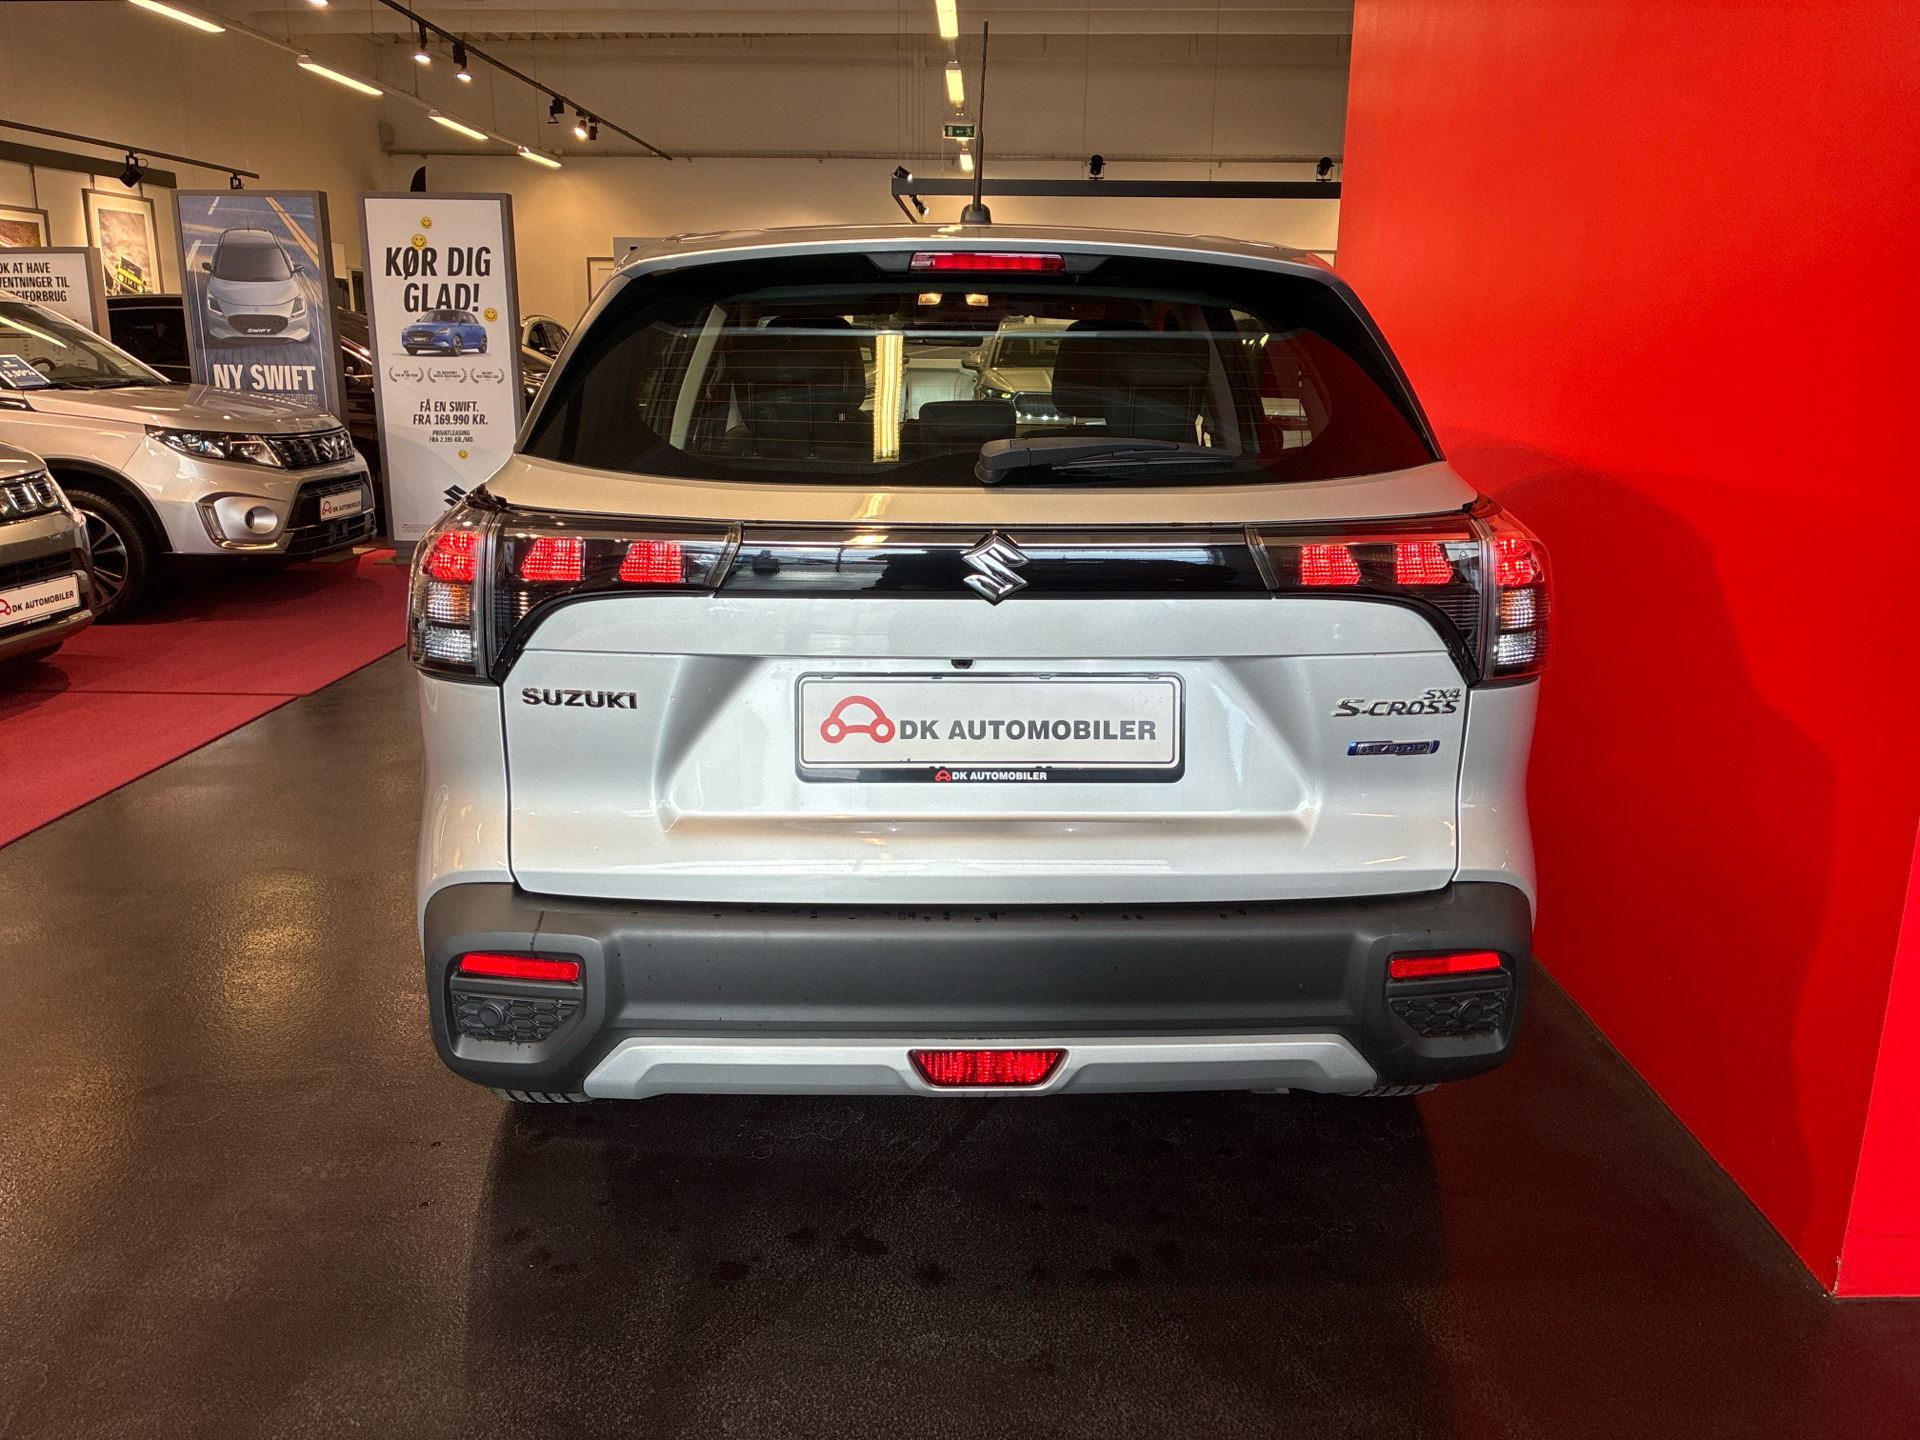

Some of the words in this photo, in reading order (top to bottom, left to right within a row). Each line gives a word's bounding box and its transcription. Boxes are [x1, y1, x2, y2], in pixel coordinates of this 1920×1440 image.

[13, 262, 23, 274] AT
[26, 262, 51, 274] HAVE
[385, 247, 438, 280] KØR
[447, 246, 491, 277] DIG
[55, 276, 70, 288] TIL
[404, 282, 480, 313] GLAD!
[213, 363, 244, 390] NY
[250, 364, 316, 391] SWIFT
[420, 398, 431, 412] FÅ
[434, 401, 446, 412] EN
[449, 401, 479, 412] SWIFT.
[413, 414, 431, 425] FRA
[434, 414, 470, 425] 169.990
[472, 414, 489, 425] KR.
[12, 603, 23, 613] DK
[25, 590, 75, 610] AUTOMOBILER
[522, 687, 638, 709] SUZUKI
[1420, 687, 1461, 700] SX4
[1330, 697, 1460, 717] S-CROSS
[899, 719, 942, 740] DK
[948, 719, 1157, 740] AUTOMOBILER
[952, 771, 968, 781] DK
[970, 771, 1048, 781] AUTOMOBILER
